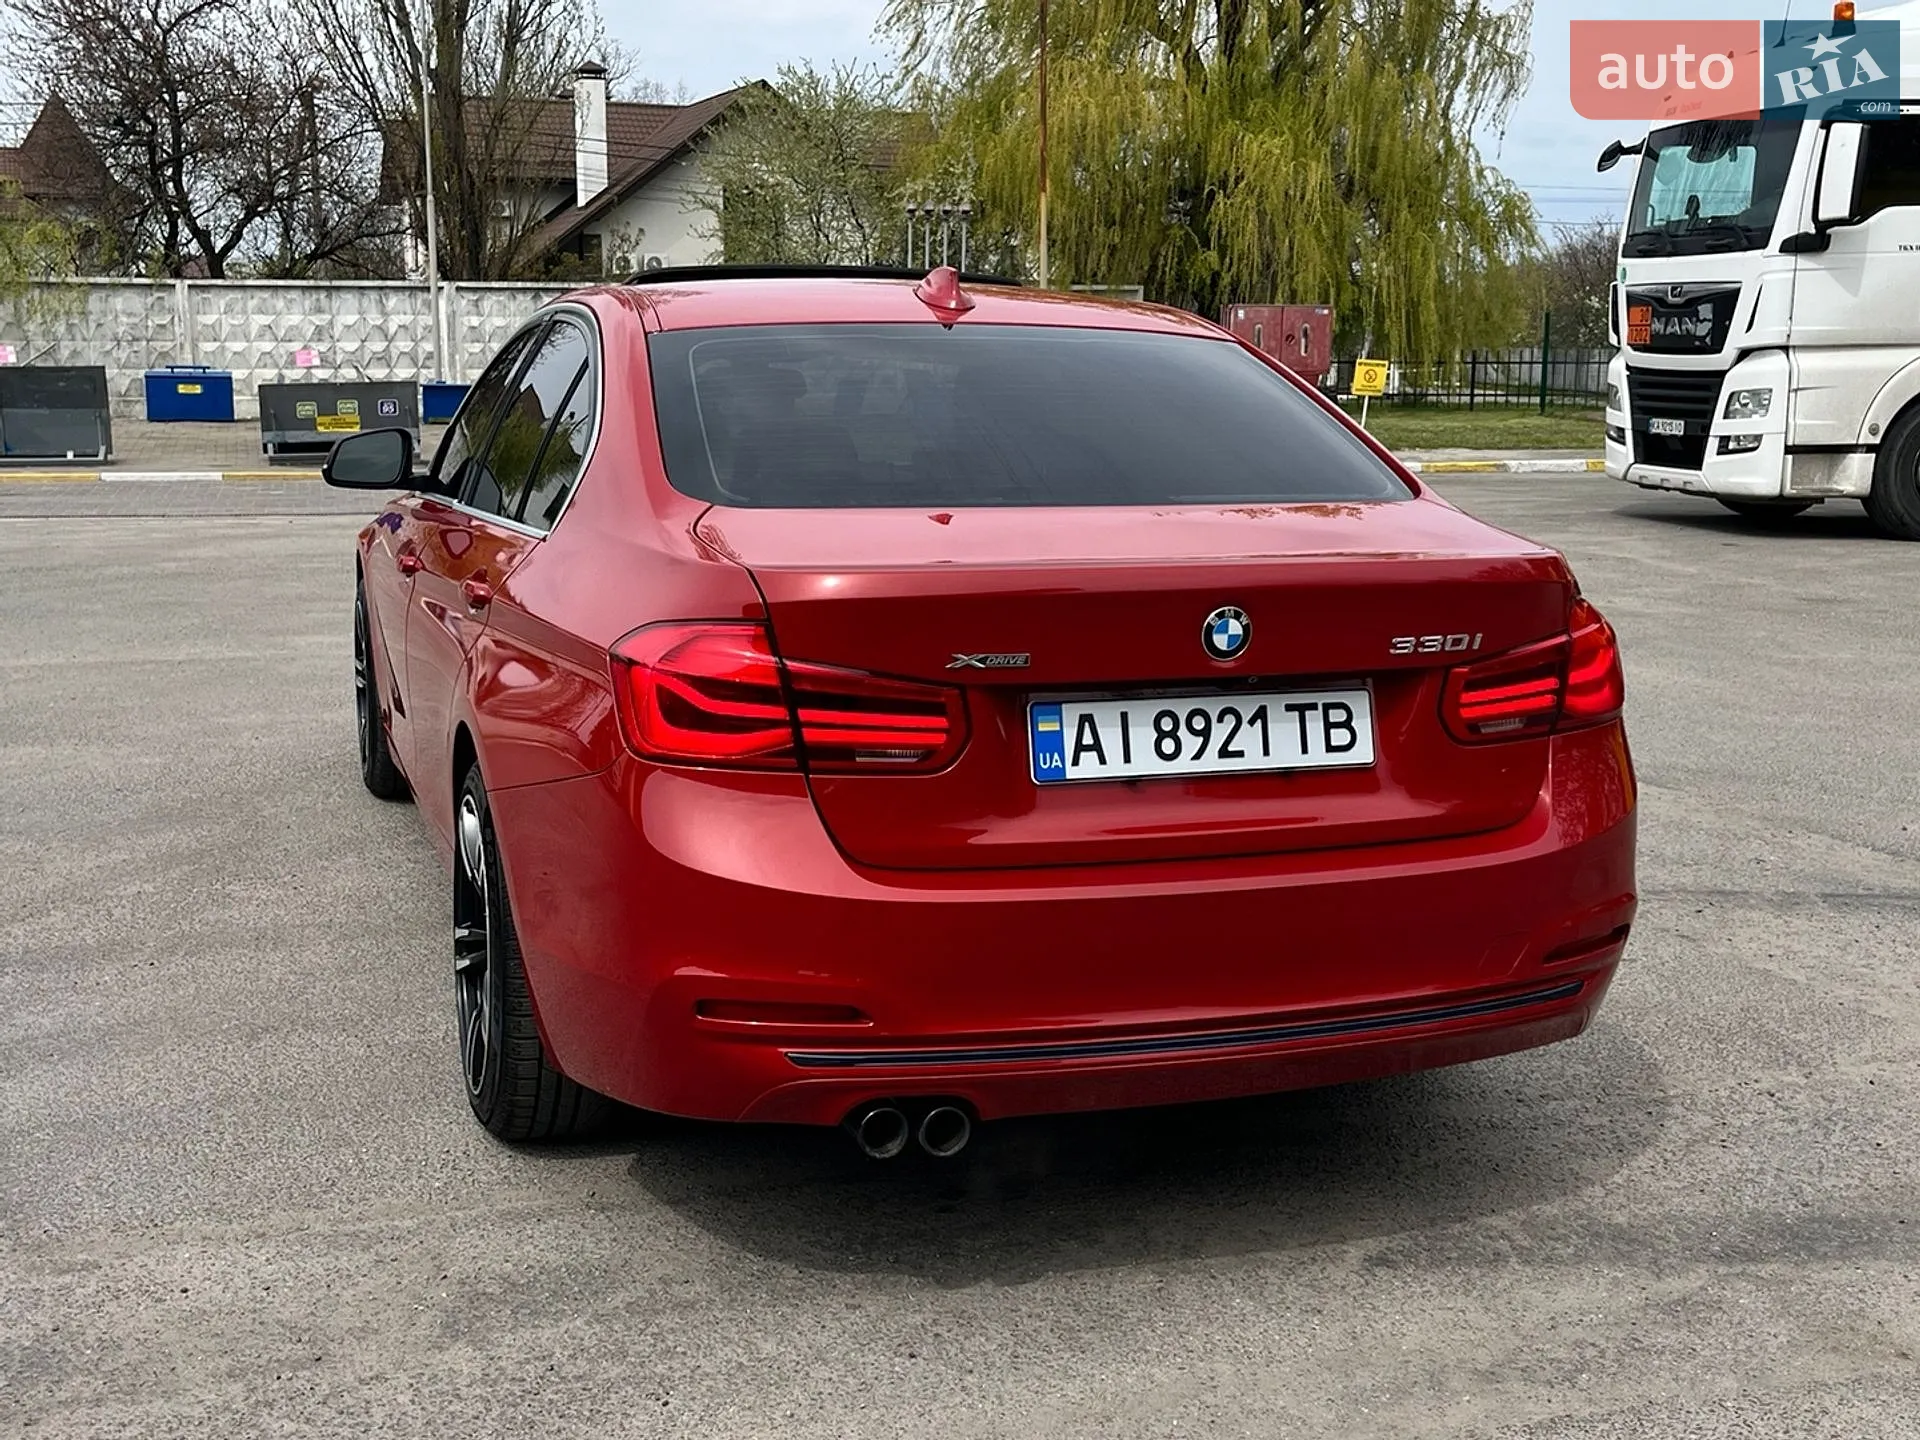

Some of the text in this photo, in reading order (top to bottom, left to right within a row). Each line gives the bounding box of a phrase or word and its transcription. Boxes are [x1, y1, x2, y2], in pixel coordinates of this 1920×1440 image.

[1652, 316, 1697, 335] MAN
[1209, 608, 1249, 626] BMW
[1071, 701, 1358, 767] AI 8921 TB
[1039, 752, 1063, 770] UA
